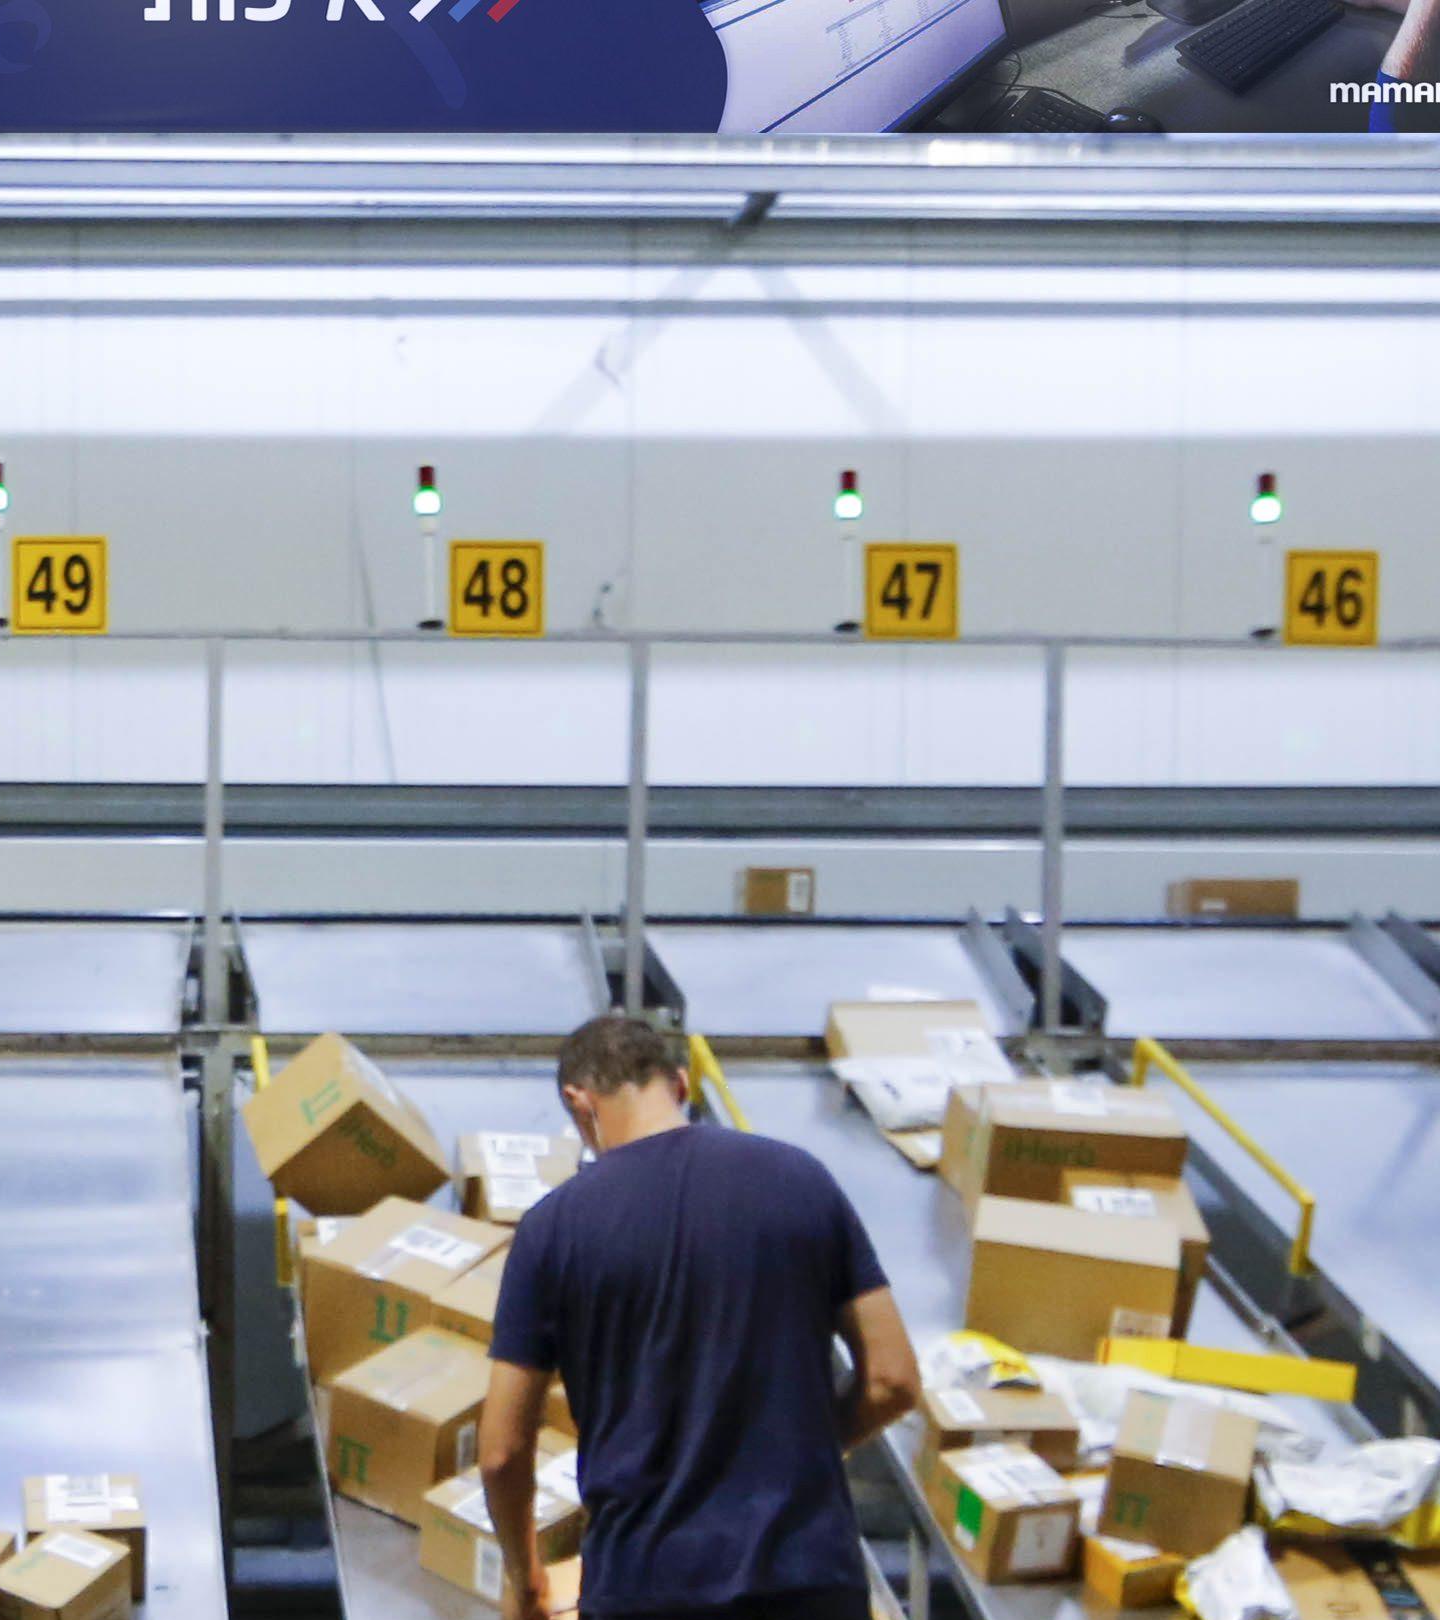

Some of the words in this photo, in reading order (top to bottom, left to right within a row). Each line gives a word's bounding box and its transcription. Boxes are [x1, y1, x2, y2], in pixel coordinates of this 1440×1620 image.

[26, 554, 93, 615] 49
[463, 558, 529, 619] 48
[880, 561, 943, 619] 47
[1298, 568, 1363, 628] 46
